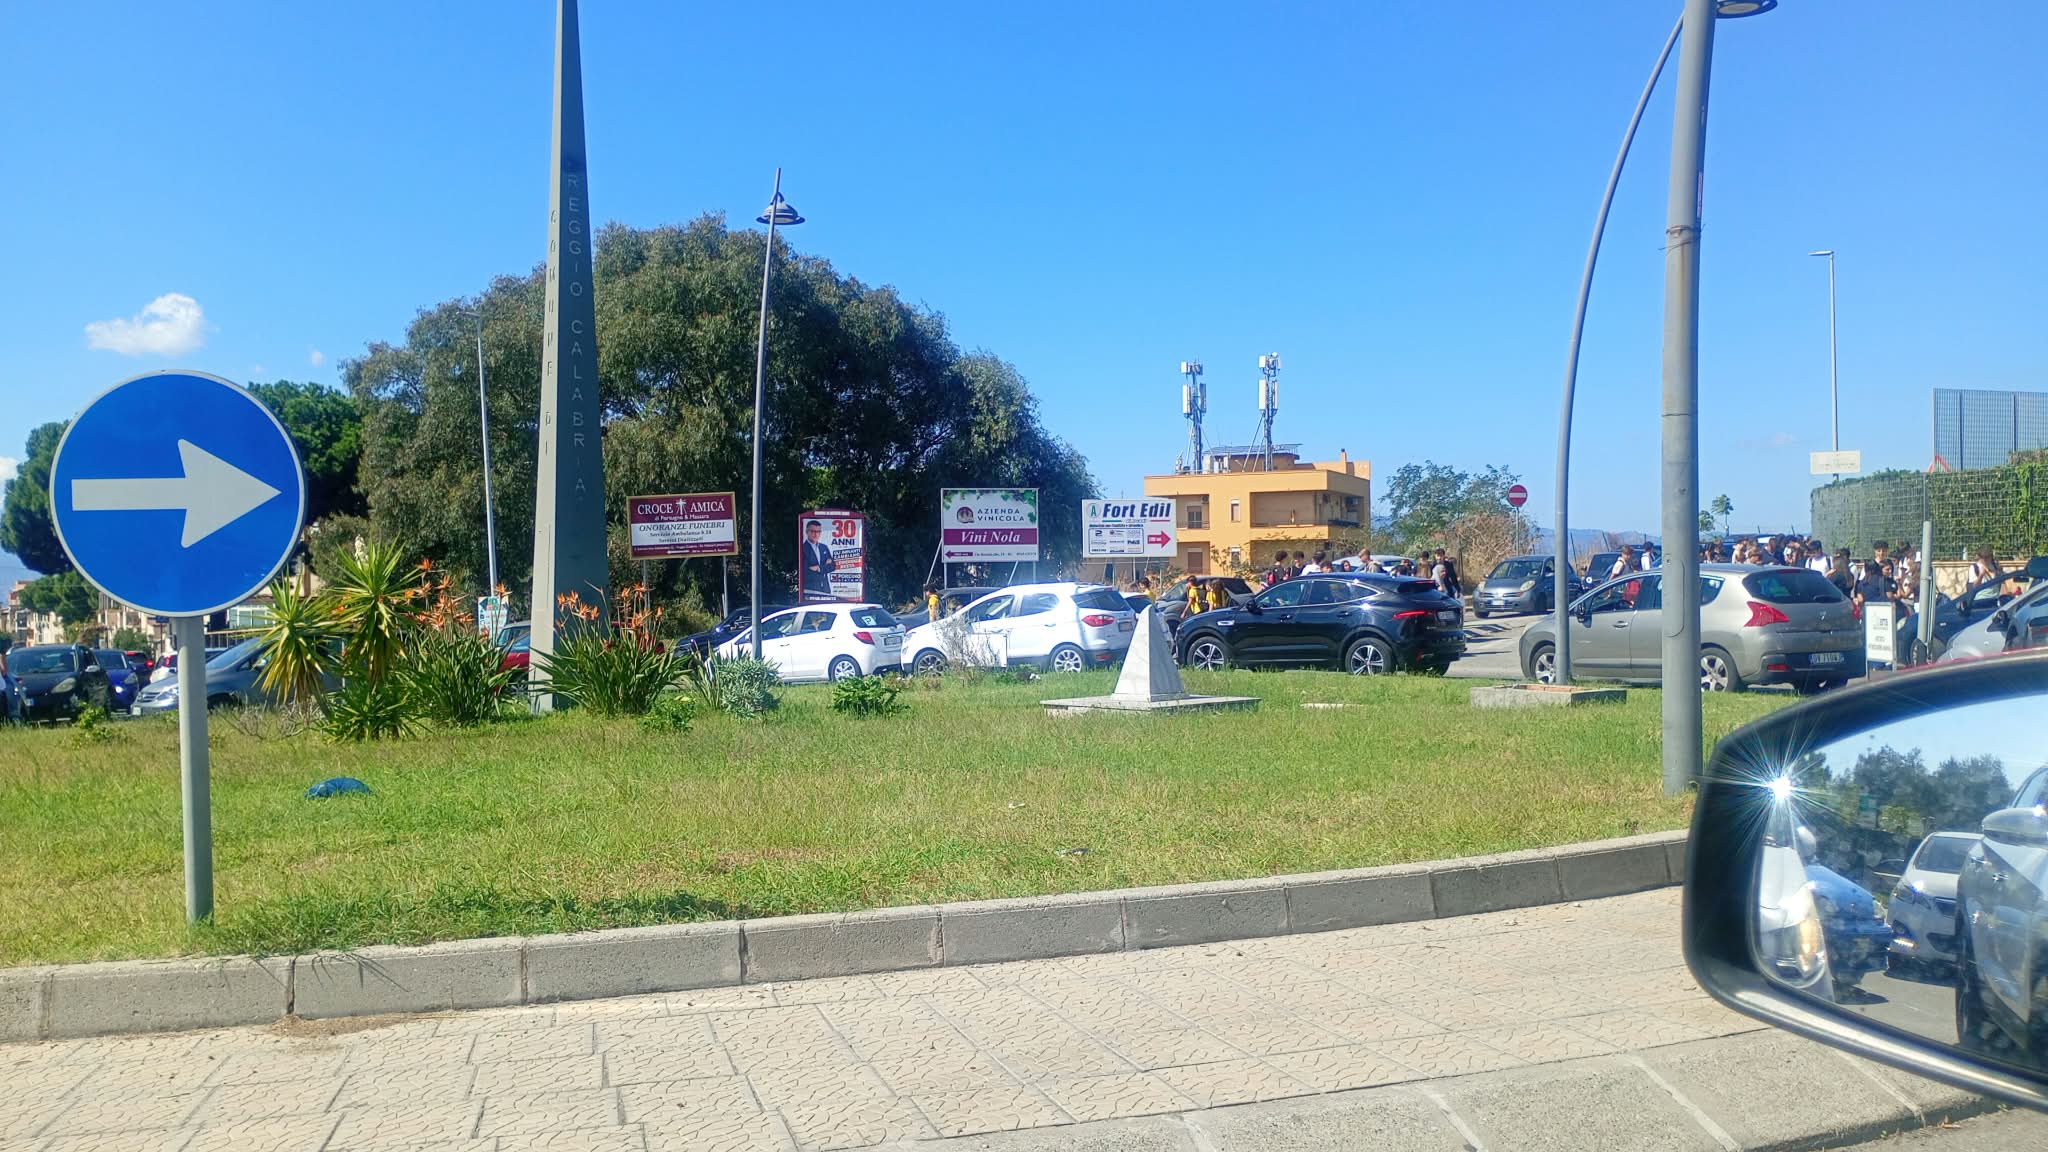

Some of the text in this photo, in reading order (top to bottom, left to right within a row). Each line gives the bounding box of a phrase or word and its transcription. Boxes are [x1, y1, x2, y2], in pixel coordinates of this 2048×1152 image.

[567, 175, 586, 492] REGGIO CALABRIA
[637, 501, 725, 515] CROCE AMICA
[1102, 503, 1171, 518] Fort Edil
[639, 521, 726, 532] ONORANZE FUNEBRI
[831, 519, 857, 538] 30
[831, 538, 855, 546] ANNI
[960, 531, 1021, 543] Vini Nola
